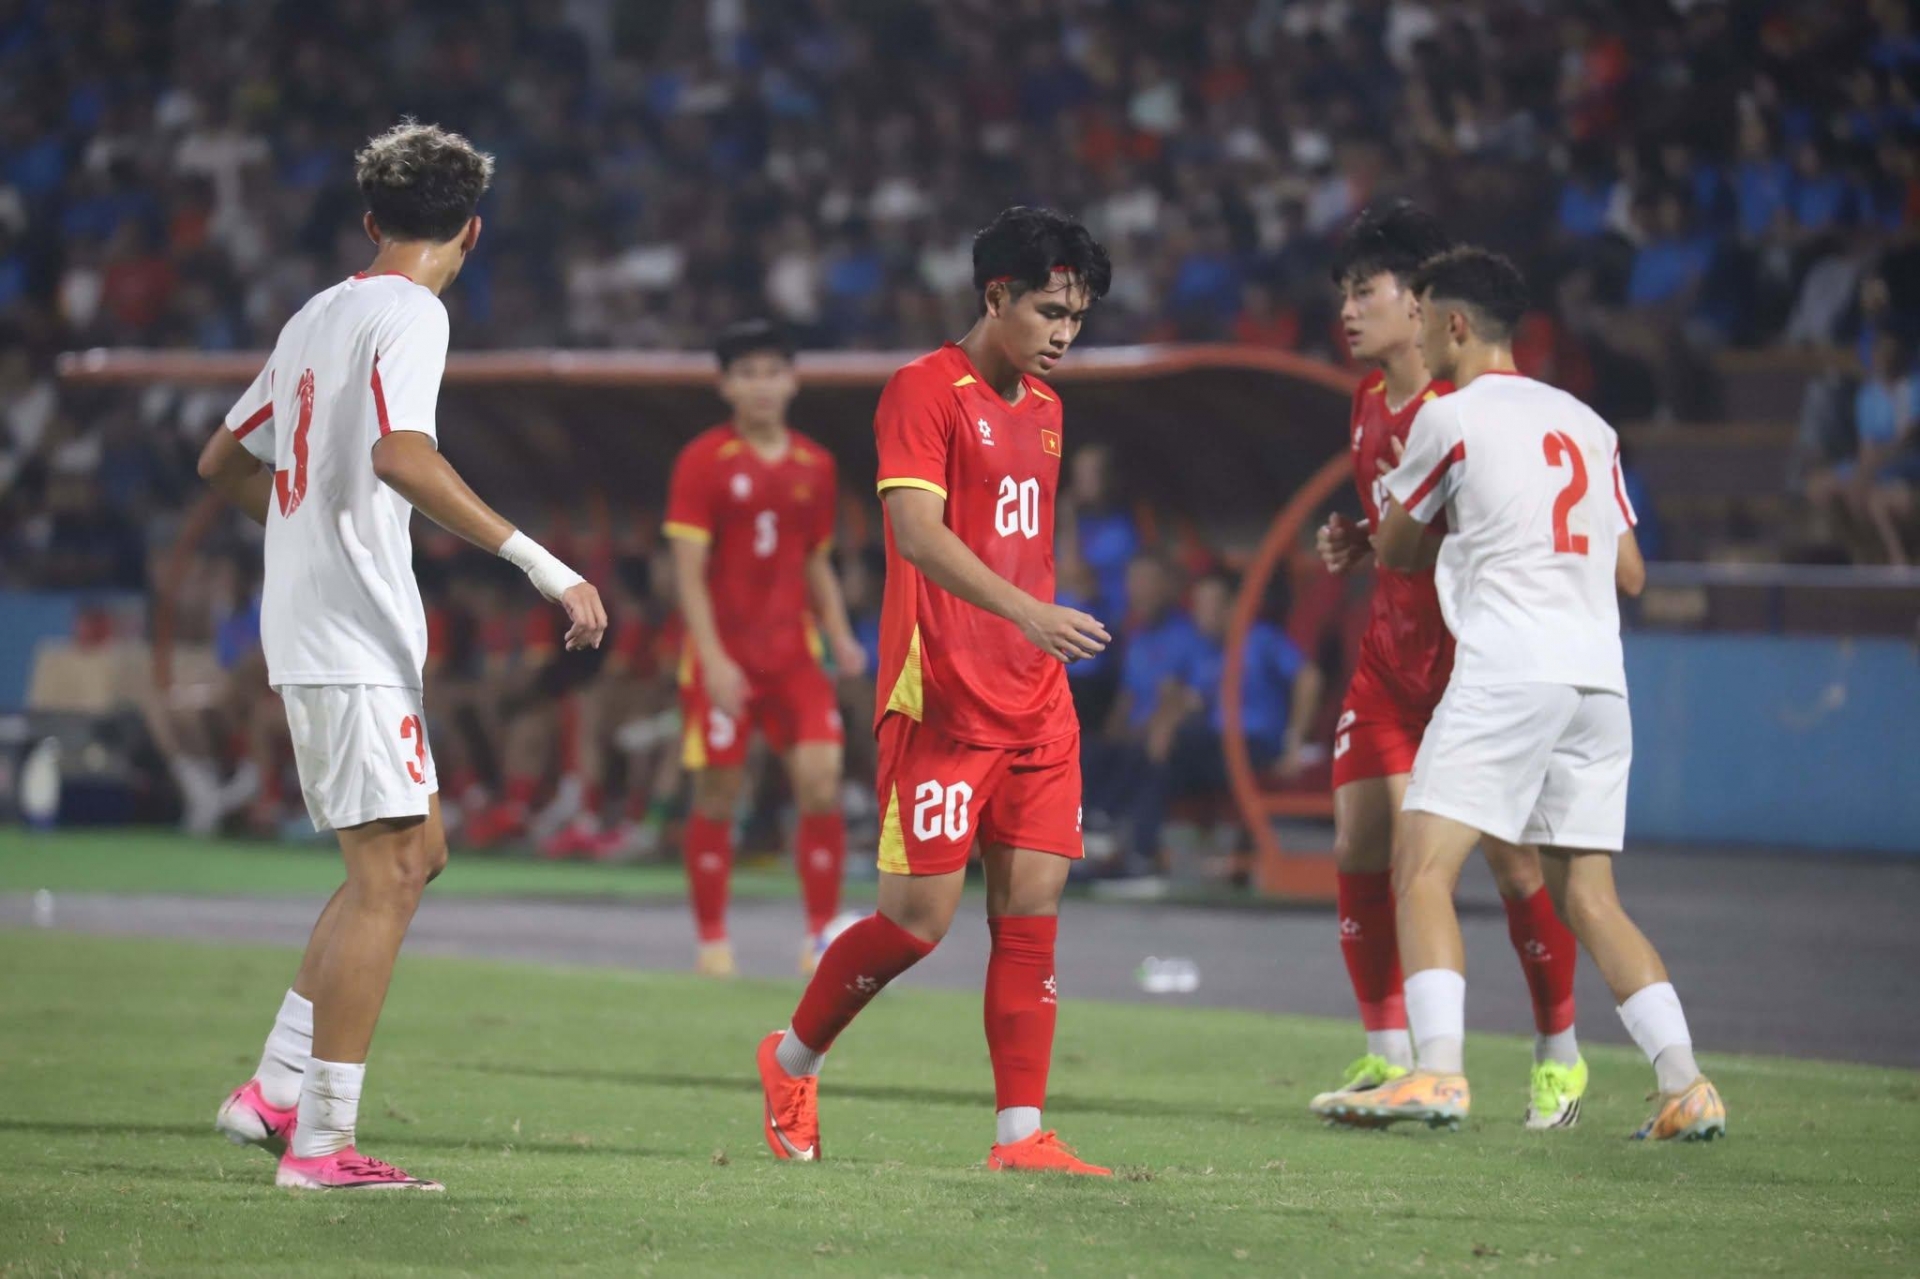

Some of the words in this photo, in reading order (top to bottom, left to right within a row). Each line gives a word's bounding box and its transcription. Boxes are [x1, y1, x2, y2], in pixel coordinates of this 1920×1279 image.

[275, 368, 314, 519] 3
[994, 475, 1040, 540] 20
[1543, 430, 1588, 556] 2
[400, 714, 426, 785] 3
[912, 779, 974, 842] 20
